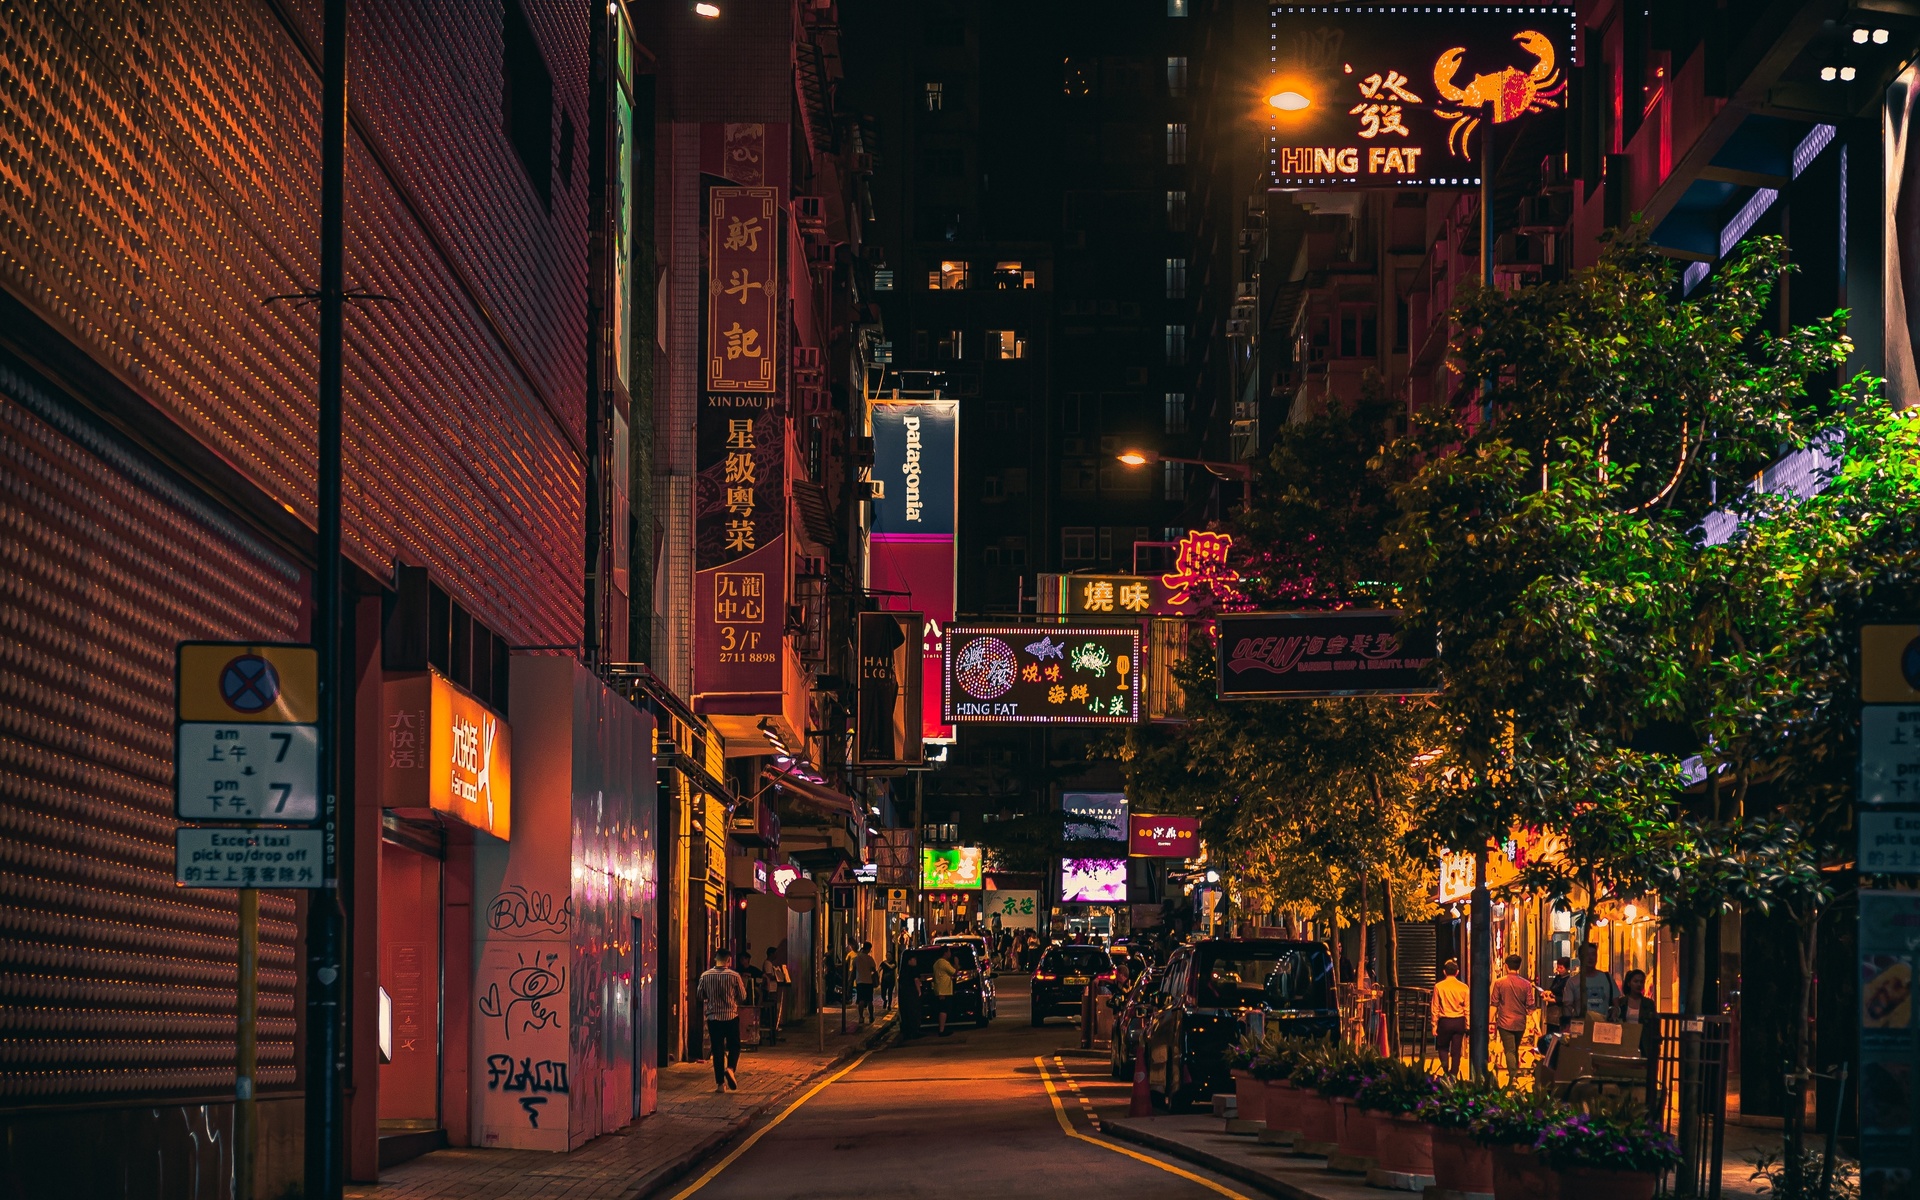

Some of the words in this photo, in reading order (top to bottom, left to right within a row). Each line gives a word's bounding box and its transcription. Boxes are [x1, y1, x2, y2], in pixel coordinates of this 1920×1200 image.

[1281, 147, 1359, 174] HING
[1368, 147, 1422, 174] FAT
[724, 215, 762, 361] 新斗記
[707, 396, 732, 408] XIN
[735, 396, 762, 408] DAU
[763, 396, 775, 410] JI
[902, 416, 921, 522] patagonia
[719, 576, 761, 597] 九龍
[1083, 581, 1150, 612] 燒味
[718, 599, 761, 619] 中心
[720, 626, 762, 651] 3/F
[719, 653, 746, 663] 2711
[749, 653, 776, 662] 8898
[1231, 635, 1303, 667] OCEAN
[1333, 660, 1357, 671] SHOP
[957, 703, 991, 715] HING
[994, 703, 1018, 715] FAT
[1088, 694, 1129, 716] 小菜
[214, 728, 239, 741] am
[389, 709, 416, 769] 大快活
[452, 713, 478, 775] 大快活
[207, 744, 247, 763] 上午
[269, 732, 292, 763] 7
[213, 779, 239, 792] pm
[206, 795, 247, 814] 下午
[268, 783, 292, 814] 7
[1071, 808, 1122, 816] HANNAH
[211, 834, 260, 848] Except
[263, 833, 290, 847] taxi
[192, 849, 222, 862] pick
[226, 849, 281, 864] up/drop
[286, 848, 307, 861] off
[185, 866, 313, 882] 的士上落客除外
